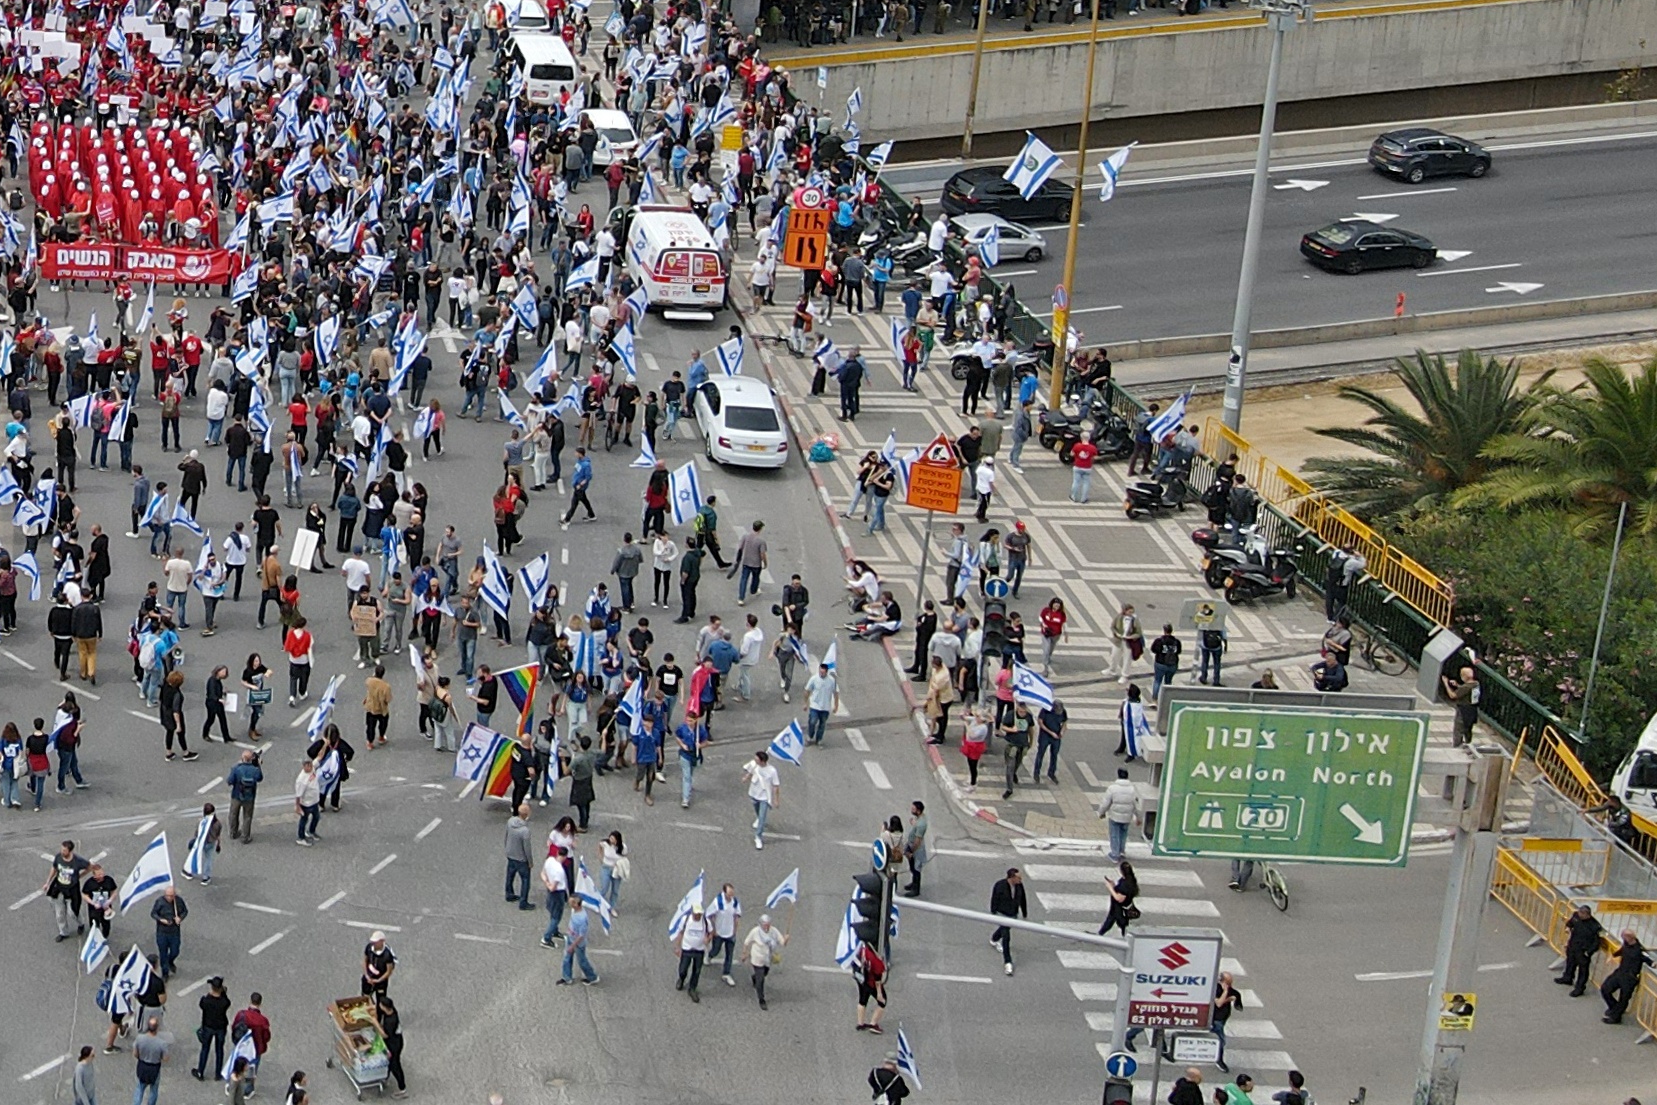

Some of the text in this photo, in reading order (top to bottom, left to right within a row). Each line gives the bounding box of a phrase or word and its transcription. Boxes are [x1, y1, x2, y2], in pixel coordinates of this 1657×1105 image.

[805, 194, 817, 203] 30
[57, 249, 176, 269] מאבק הנשים
[1205, 726, 1390, 755] אילון צפון
[1191, 761, 1393, 786] Ayalon North
[1247, 808, 1277, 825] 20
[1135, 973, 1207, 986] SUZUKI
[1135, 1004, 1199, 1015] מגדל סוזוקי
[1131, 1015, 1199, 1026] יגאל אלון 62
